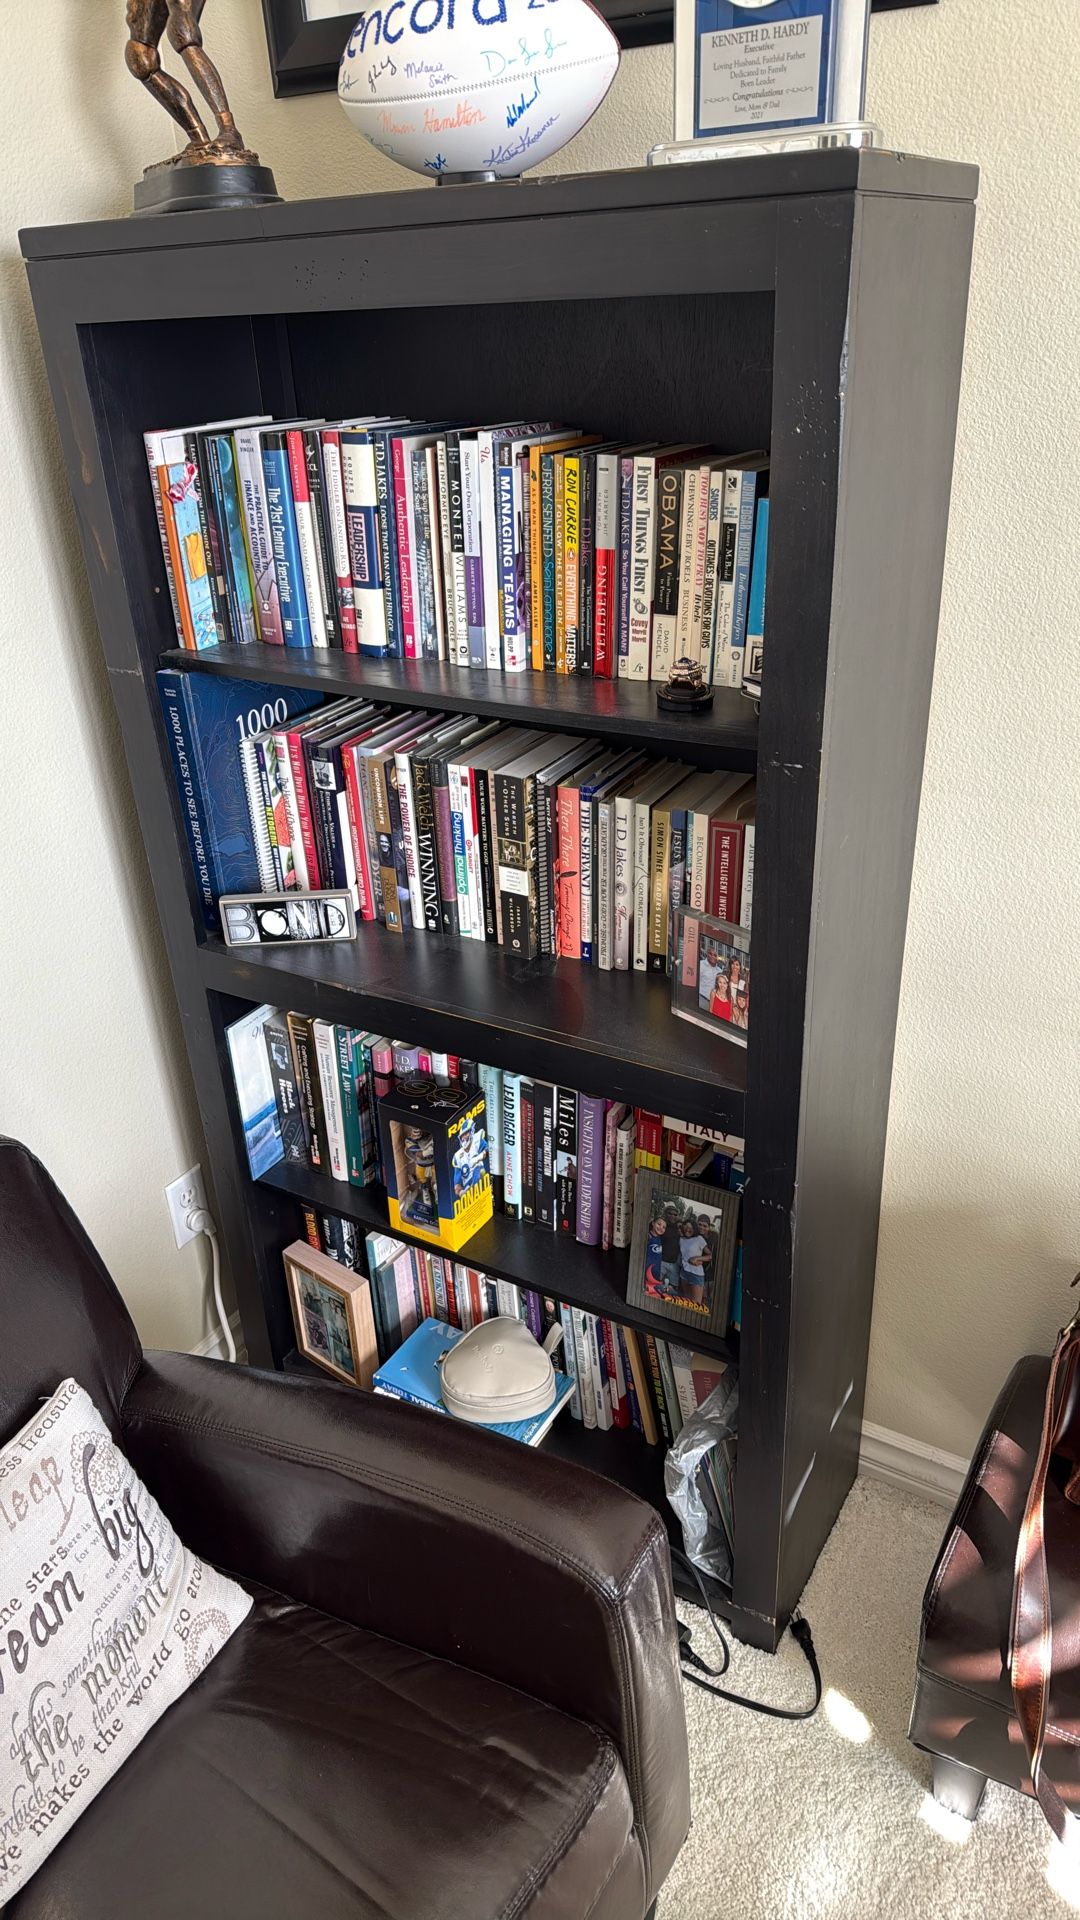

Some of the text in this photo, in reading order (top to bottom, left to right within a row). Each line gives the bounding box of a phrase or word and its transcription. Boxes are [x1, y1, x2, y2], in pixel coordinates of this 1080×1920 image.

[712, 22, 810, 48] KENNETH D. HARDY
[744, 43, 774, 53] Executive
[713, 52, 805, 71] Loving Husband, Faithful Father
[730, 68, 759, 79] Dedicated
[768, 65, 787, 74] Family
[740, 77, 776, 88] Born Leader
[732, 89, 783, 101] Congratulations
[373, 441, 388, 500] T.D. JAKES
[254, 496, 265, 535] PRACTICAL
[329, 450, 347, 572] THE FIDDLER ON PANTICO RUN
[439, 469, 448, 520] INFORMED
[621, 490, 631, 544] T.D. JAKES
[244, 479, 254, 511] FINANCE
[250, 527, 262, 575] ACCOUNTING
[268, 487, 291, 603] The 21st Century Executive
[466, 509, 475, 553] Corporation
[634, 465, 652, 595] FIRST THINGS FIRST
[659, 474, 677, 571] OBAMA
[259, 536, 268, 560] GUIDE
[262, 561, 269, 571] TO
[351, 514, 367, 580] LEADERSHIP
[396, 493, 414, 613] Authentic Leadership
[450, 480, 467, 623] MONTEL WILLIAMS
[499, 475, 516, 629] MANAGING TEAMS
[542, 462, 553, 653] JERRY SEINFELD SeinLanguage
[566, 468, 577, 668] RON CURRIE EVERYTHING MATTERS!
[701, 488, 719, 649] SANDERS OUTTAKES: DEVOTIONS FOR GUYS
[735, 480, 754, 641] JOHN EDGAR WIDEMAN Brothers and Keepers
[446, 588, 454, 618] BRUCE
[595, 563, 607, 661] WELLBEING
[448, 620, 456, 643] COLE
[655, 622, 663, 659] MENDELL
[662, 630, 670, 654] DAVID
[175, 734, 191, 779] PLACES
[183, 780, 194, 797] TO
[186, 796, 198, 820] SEE
[372, 767, 383, 809] UNCOMMON
[398, 783, 416, 879] THE POWER OF CHOICE
[502, 788, 511, 837] OTHER SUNS
[510, 803, 518, 835] WARMTH
[560, 799, 573, 867] There There
[656, 822, 665, 848] SIMON
[190, 819, 207, 865] BEFORE
[413, 761, 438, 919] Jack Welch WINNING
[581, 807, 591, 890] THE SERVANT
[616, 814, 627, 877] T. D. Jakes
[656, 851, 664, 873] SINEK
[198, 864, 211, 888] YOU
[719, 835, 730, 895] THE INTELLIGENT
[202, 887, 214, 907] DIE
[508, 897, 516, 933] WILKERSON
[655, 879, 663, 911] LEADERS
[337, 1034, 354, 1095] STREET LAW
[279, 1077, 289, 1114] Heroes
[286, 1080, 295, 1110] Black
[503, 1084, 516, 1147] LEAD BIGGER
[448, 1100, 486, 1138] RAMS
[559, 1094, 574, 1147] Miles
[583, 1109, 593, 1155] INSIGHTS
[685, 1120, 729, 1142] ITALY
[454, 1173, 490, 1215] DONALD
[580, 1170, 591, 1228] LEADERSHIP
[305, 1212, 317, 1237] BLOOD
[82, 1443, 154, 1579] big
[26, 1545, 69, 1594] stars
[28, 1640, 173, 1837] makes the world
